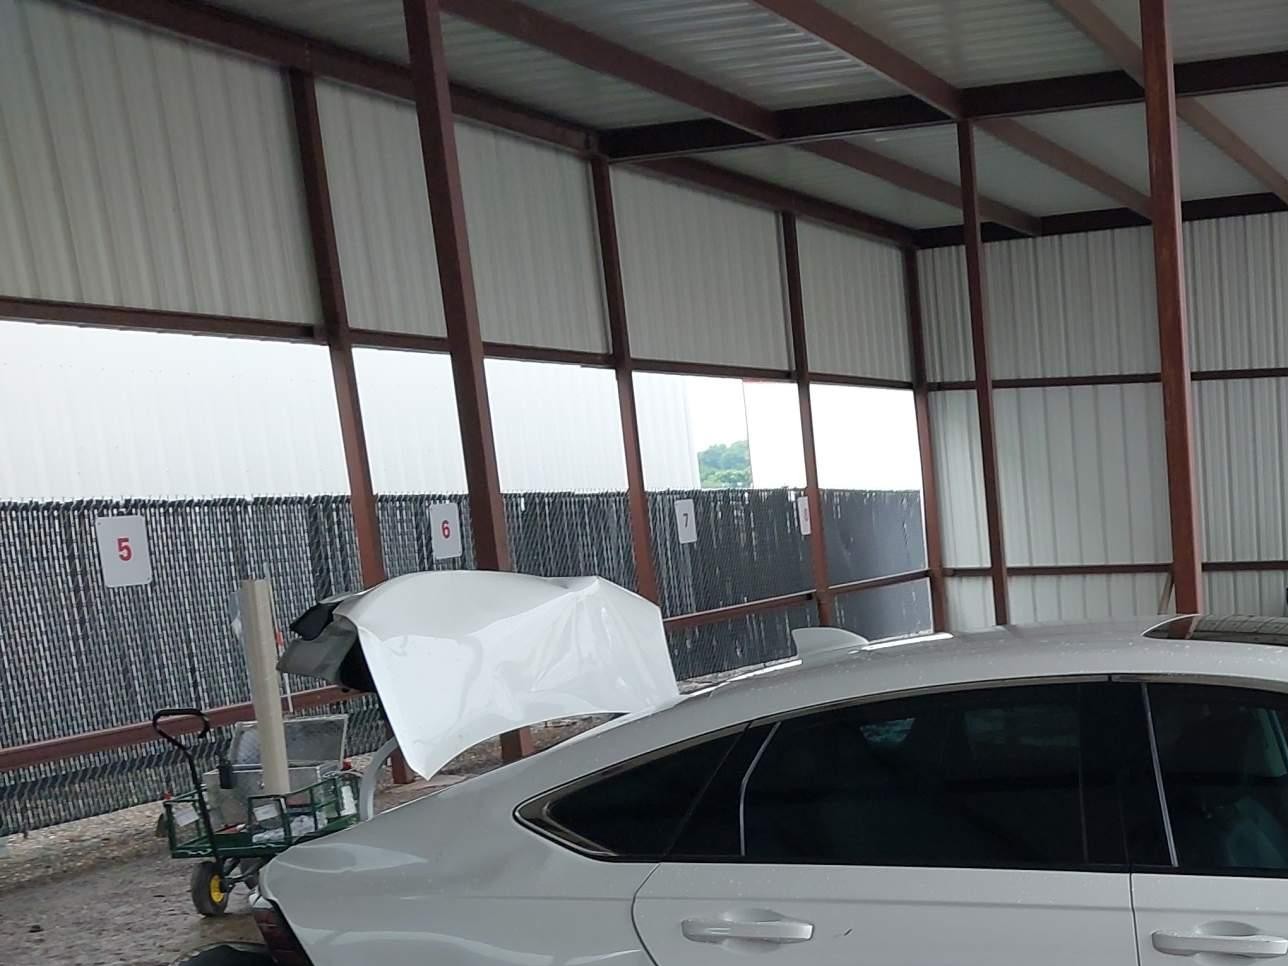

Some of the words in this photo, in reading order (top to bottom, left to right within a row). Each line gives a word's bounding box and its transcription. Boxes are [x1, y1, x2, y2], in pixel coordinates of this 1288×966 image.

[441, 519, 450, 539] 6
[682, 512, 689, 528] 7
[117, 537, 132, 562] 5
